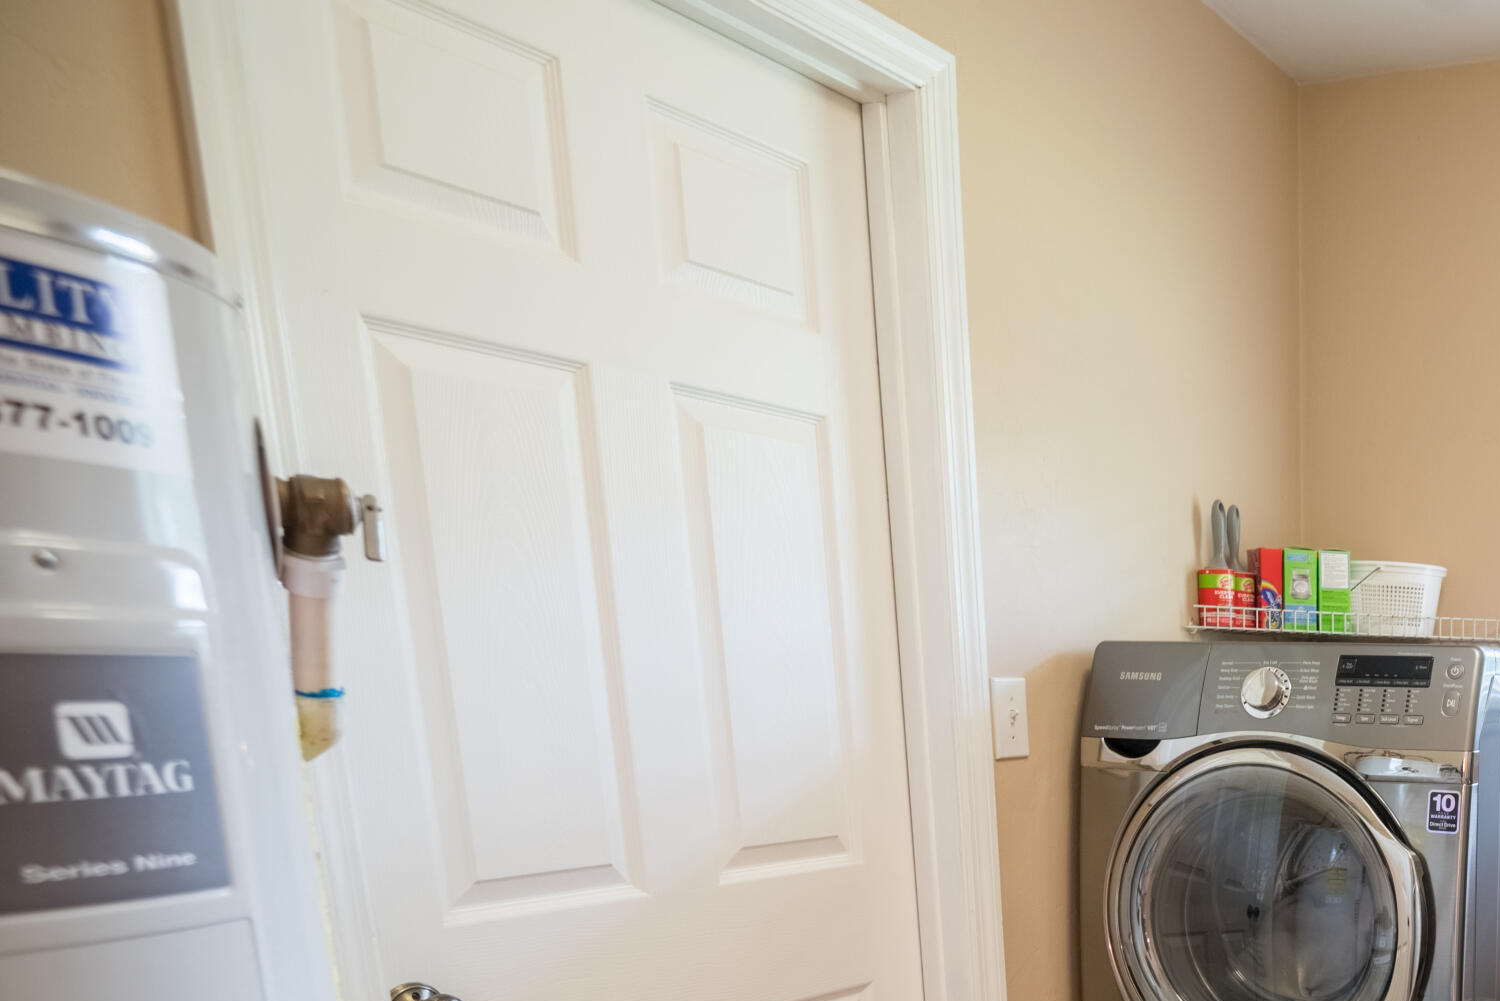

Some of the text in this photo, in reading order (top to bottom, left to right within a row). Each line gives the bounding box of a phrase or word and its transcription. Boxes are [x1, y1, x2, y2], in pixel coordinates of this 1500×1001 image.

[0, 261, 118, 327] LIT
[0, 397, 154, 449] 77-1009
[1120, 671, 1163, 681] SAMSUNG
[0, 758, 195, 804] MAYTAG
[1433, 794, 1456, 812] 10
[18, 851, 198, 886] Series Nine
